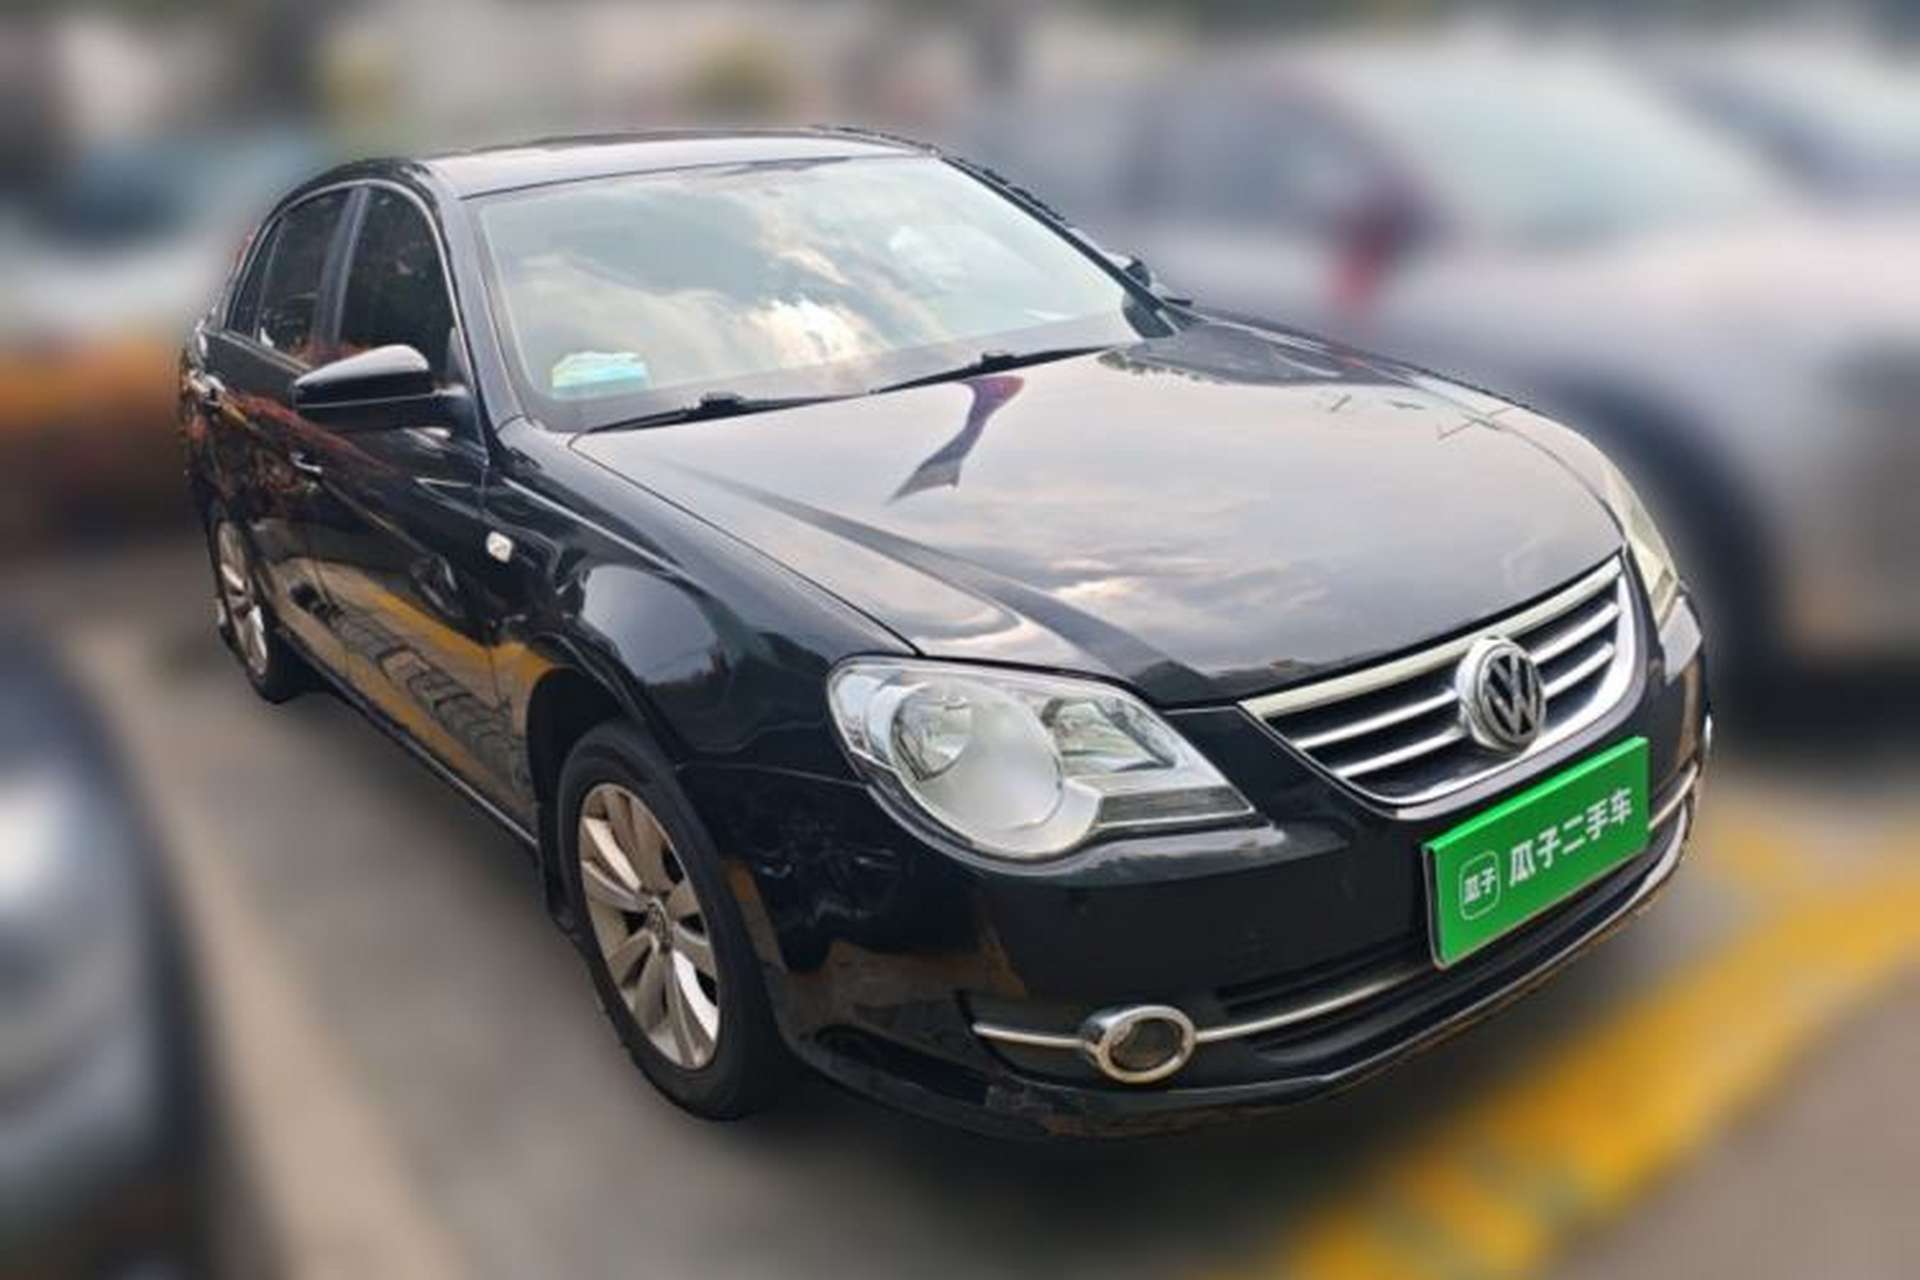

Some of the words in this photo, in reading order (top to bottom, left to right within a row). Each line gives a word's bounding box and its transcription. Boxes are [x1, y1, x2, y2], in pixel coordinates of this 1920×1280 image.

[1509, 787, 1633, 887] 瓜子二手车
